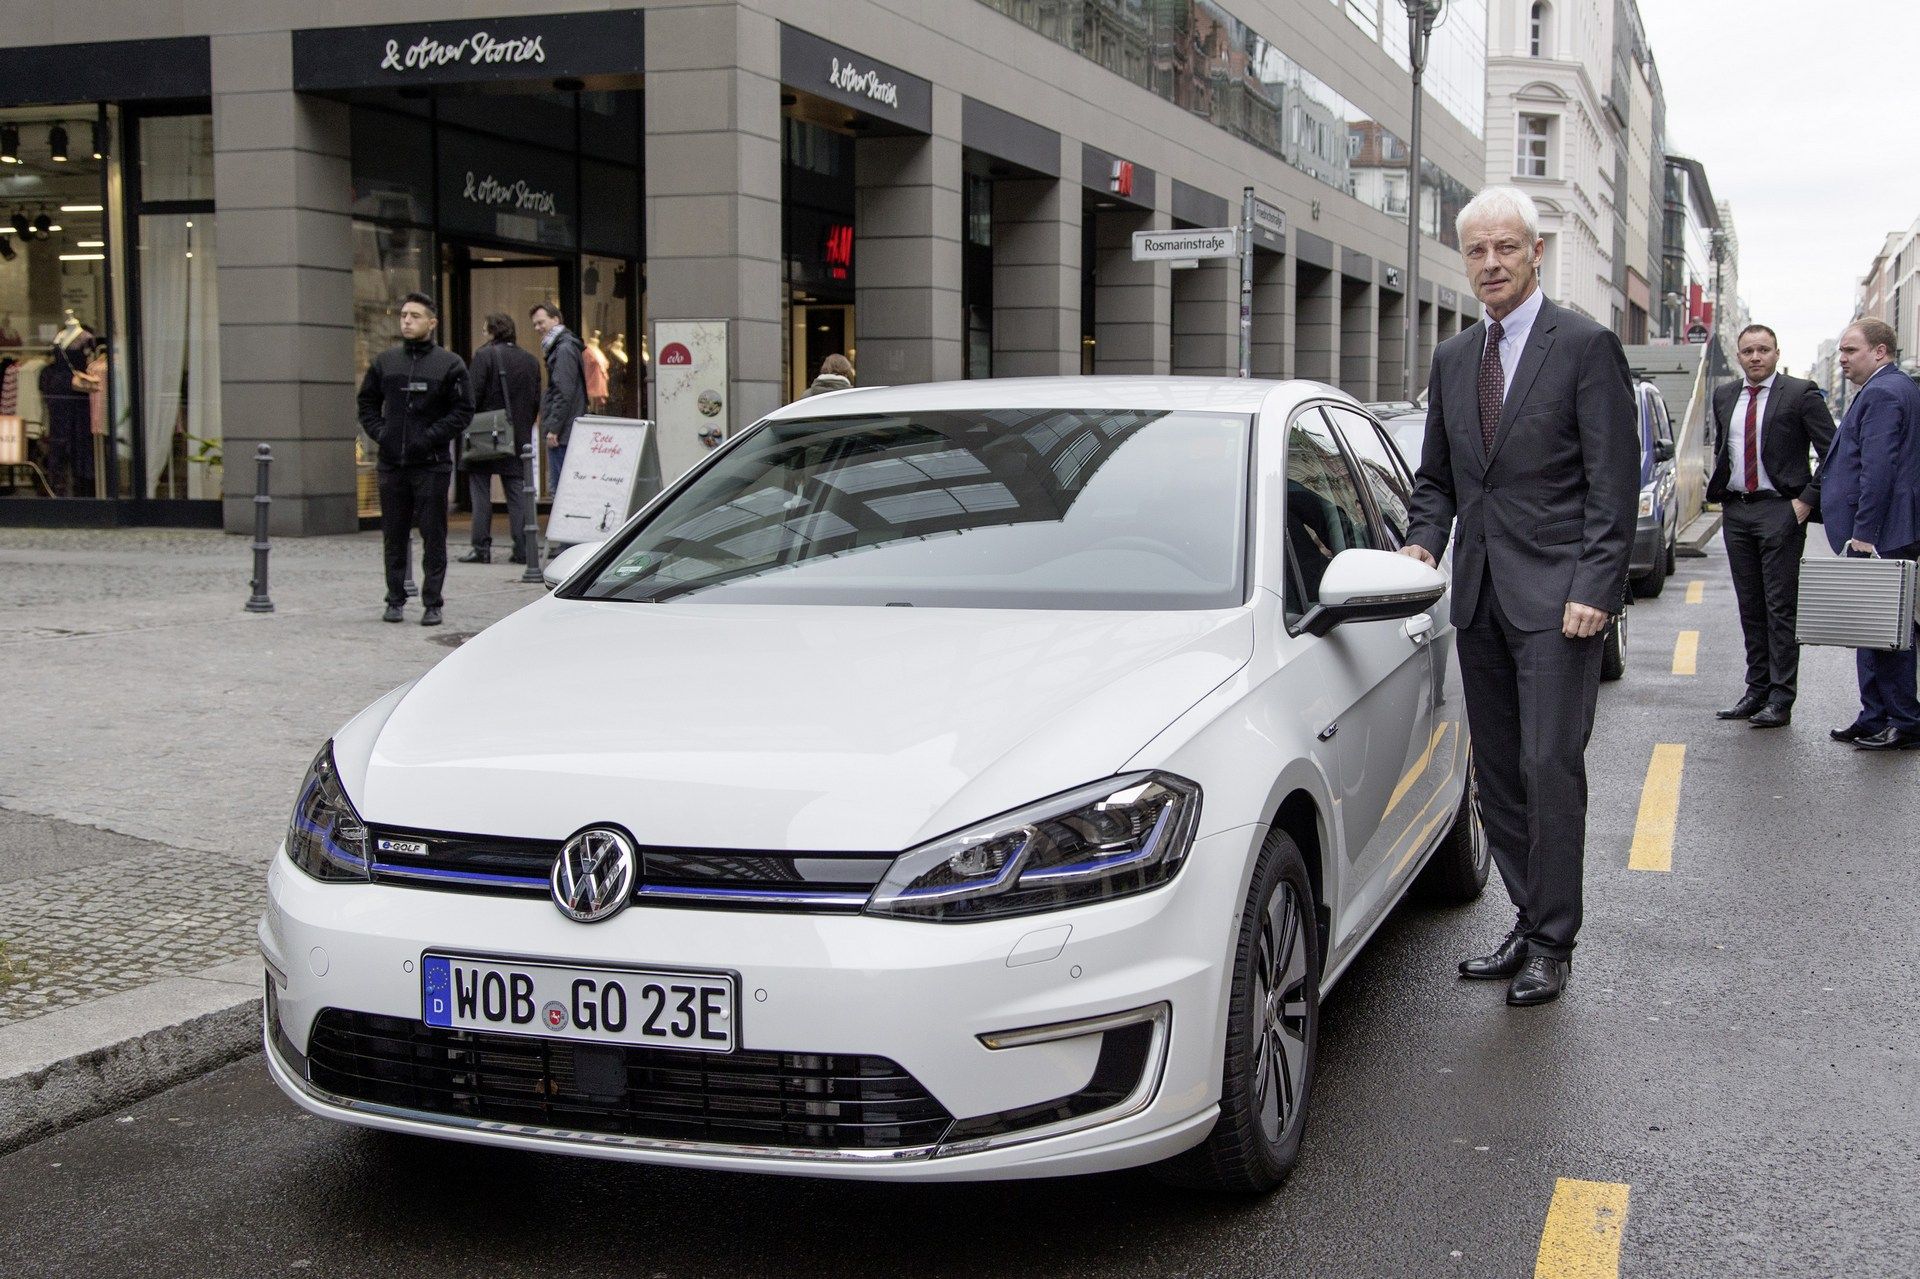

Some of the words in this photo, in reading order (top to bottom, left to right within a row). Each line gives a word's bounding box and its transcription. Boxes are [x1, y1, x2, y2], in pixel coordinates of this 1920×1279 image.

[381, 39, 404, 71] &
[470, 31, 546, 65] Stories
[829, 57, 842, 88] &
[867, 70, 898, 109] Stories
[463, 171, 477, 202] &
[515, 180, 555, 217] Stories
[1144, 235, 1225, 252] Rosmarinstraße
[666, 350, 685, 364] edo
[382, 841, 420, 852] e-GOLF
[433, 998, 444, 1014] D
[454, 967, 536, 1025] WOB
[571, 978, 627, 1033] GO
[641, 983, 728, 1041] 23E
